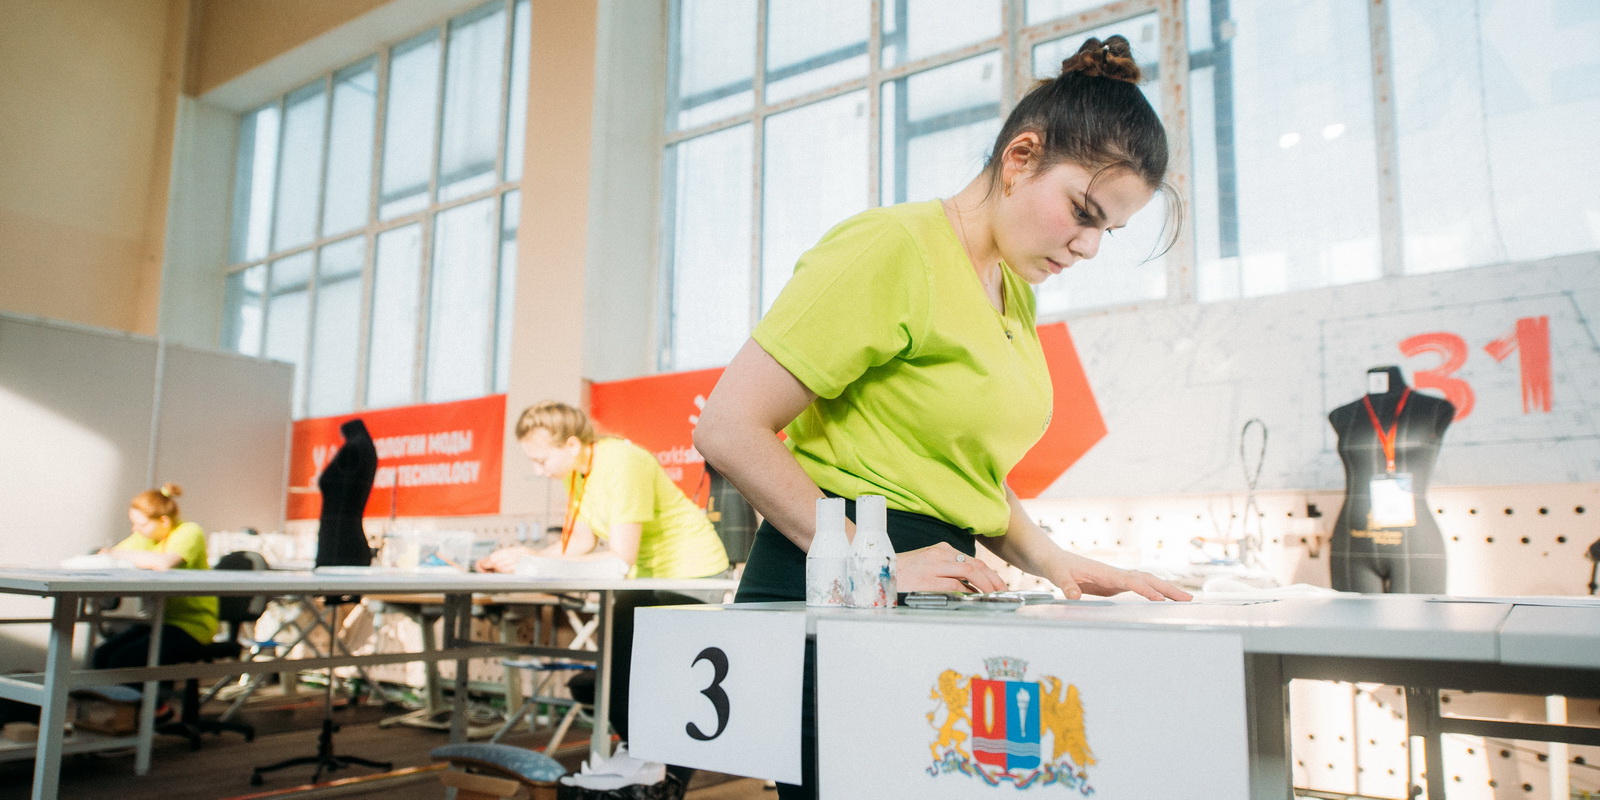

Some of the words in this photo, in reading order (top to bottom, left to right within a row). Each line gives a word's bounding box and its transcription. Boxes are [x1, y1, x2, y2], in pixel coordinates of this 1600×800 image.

[1398, 315, 1553, 422] 31
[428, 430, 473, 455] МОДЫ
[398, 461, 480, 487] TECHNOLOGY
[685, 646, 730, 741] 3
